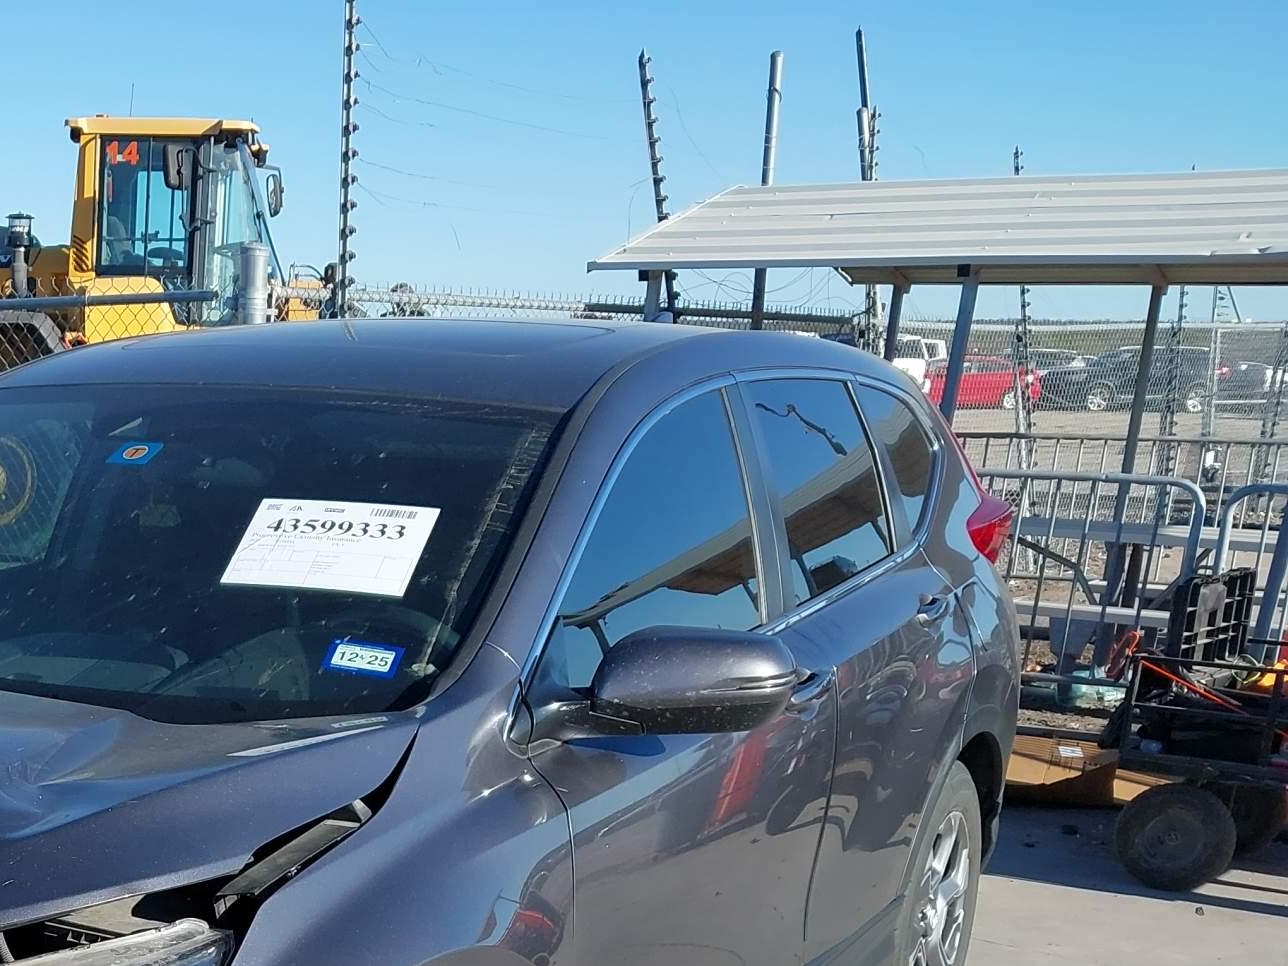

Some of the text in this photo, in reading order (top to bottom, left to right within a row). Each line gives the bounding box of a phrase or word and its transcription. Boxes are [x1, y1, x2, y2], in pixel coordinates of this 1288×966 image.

[105, 140, 140, 166] 14
[265, 517, 407, 540] 43599333
[338, 651, 390, 667] 12 25
